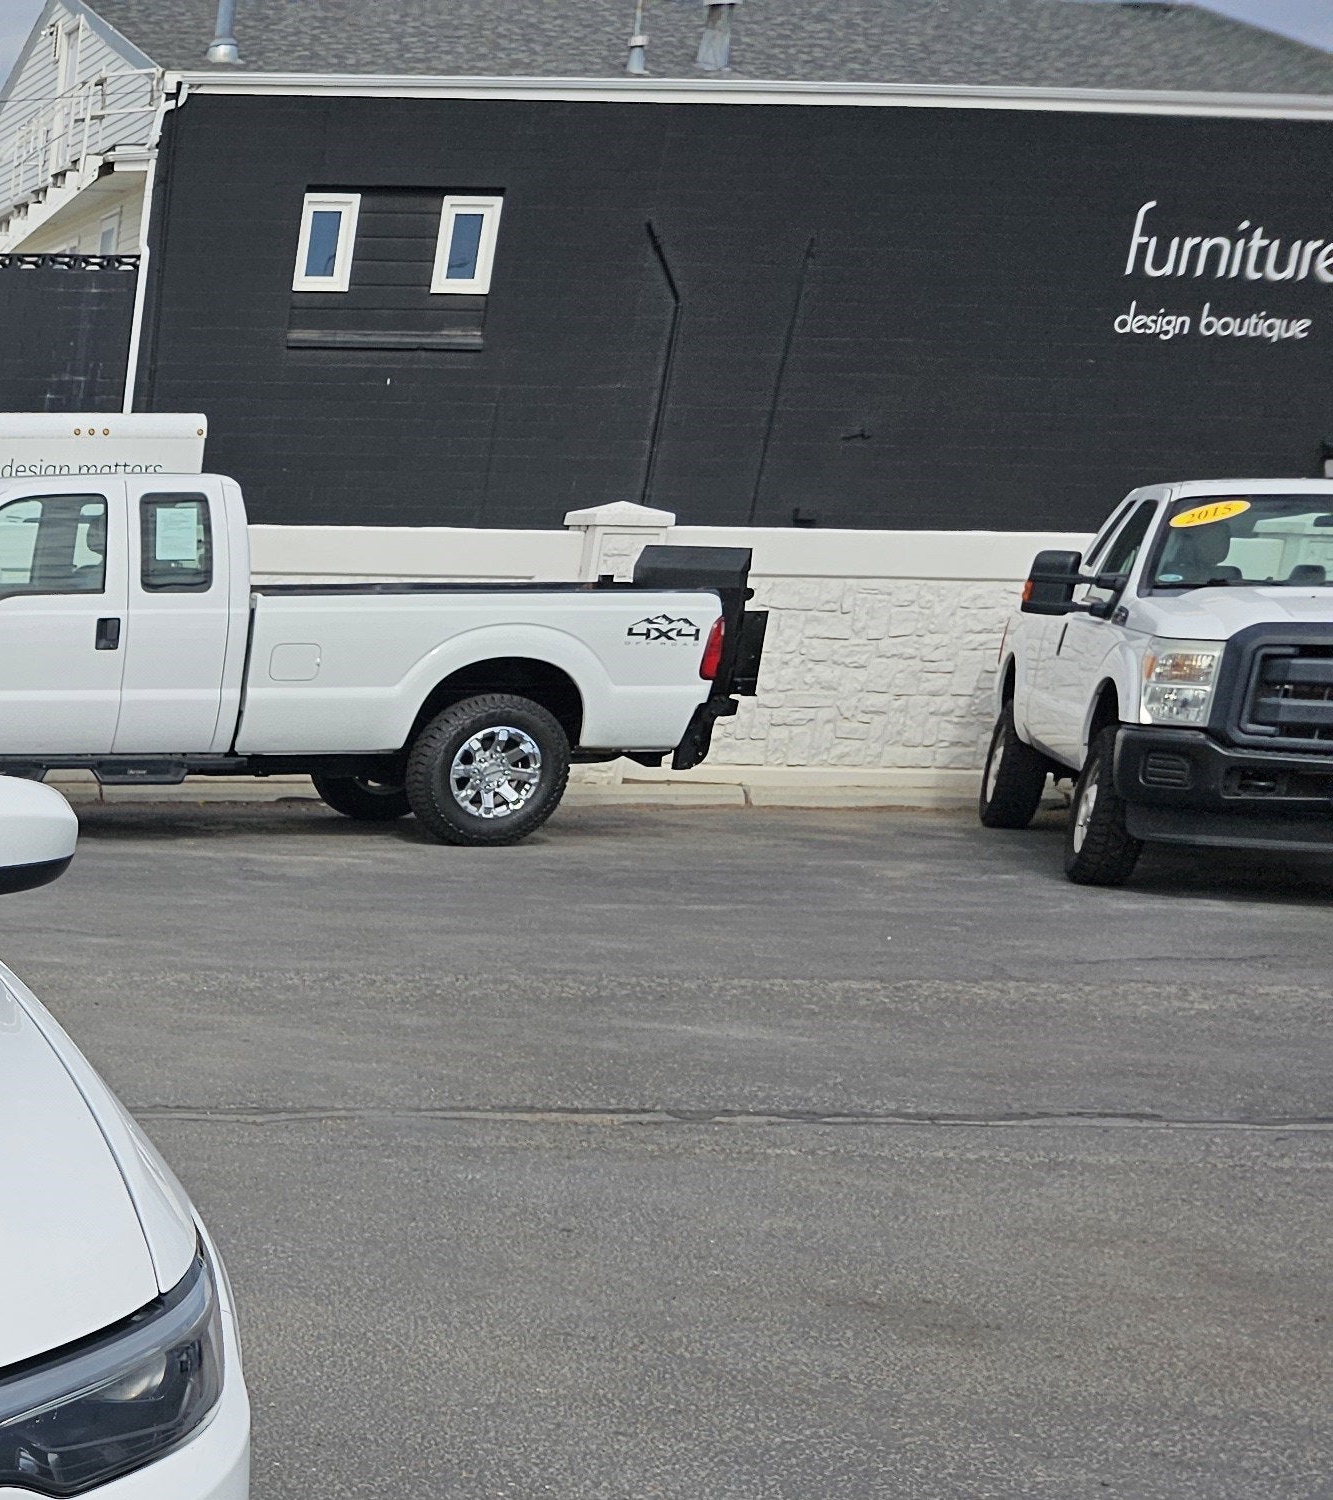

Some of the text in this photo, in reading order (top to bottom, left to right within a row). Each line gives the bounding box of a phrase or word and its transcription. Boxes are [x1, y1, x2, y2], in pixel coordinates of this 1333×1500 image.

[1123, 200, 1333, 284] furniture
[1113, 299, 1313, 344] design boutique
[0, 458, 164, 478] design matters
[1185, 504, 1232, 524] 2015
